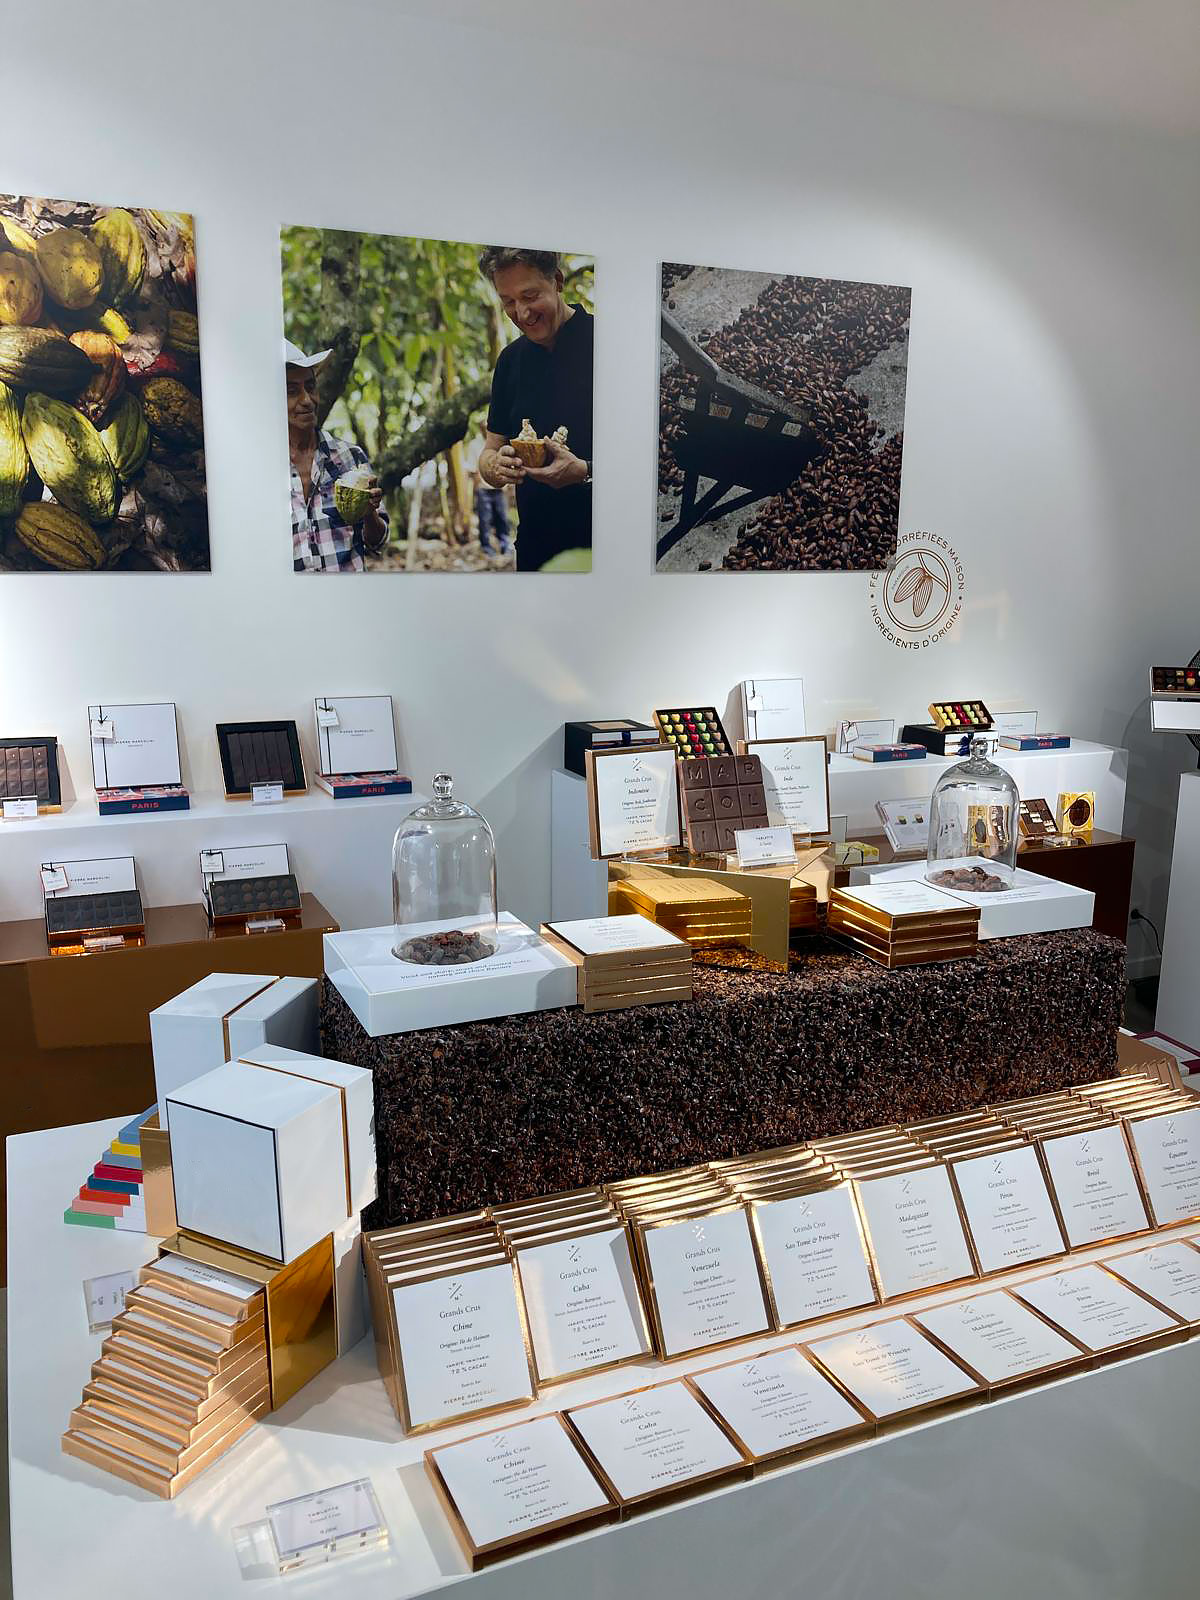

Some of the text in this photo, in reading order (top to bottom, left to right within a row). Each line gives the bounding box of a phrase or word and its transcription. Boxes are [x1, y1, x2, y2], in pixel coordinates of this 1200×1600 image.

[947, 548, 964, 590] MAISON
[870, 603, 962, 650] INGRÉDIENTS D'ORIGINE
[361, 785, 385, 794] PARIS
[685, 1249, 706, 1260] Grands
[691, 1261, 720, 1272] Venezuela
[560, 1265, 598, 1280] Grands Crus
[573, 1283, 590, 1293] Cuba
[440, 1304, 481, 1319] Grands Crus
[453, 1322, 473, 1332] Chine
[754, 1383, 785, 1396] Venezuela
[620, 1414, 645, 1424] Grands
[639, 1422, 657, 1430] Cuba
[486, 1446, 532, 1463] Grands Crus
[504, 1459, 525, 1470] Chine
